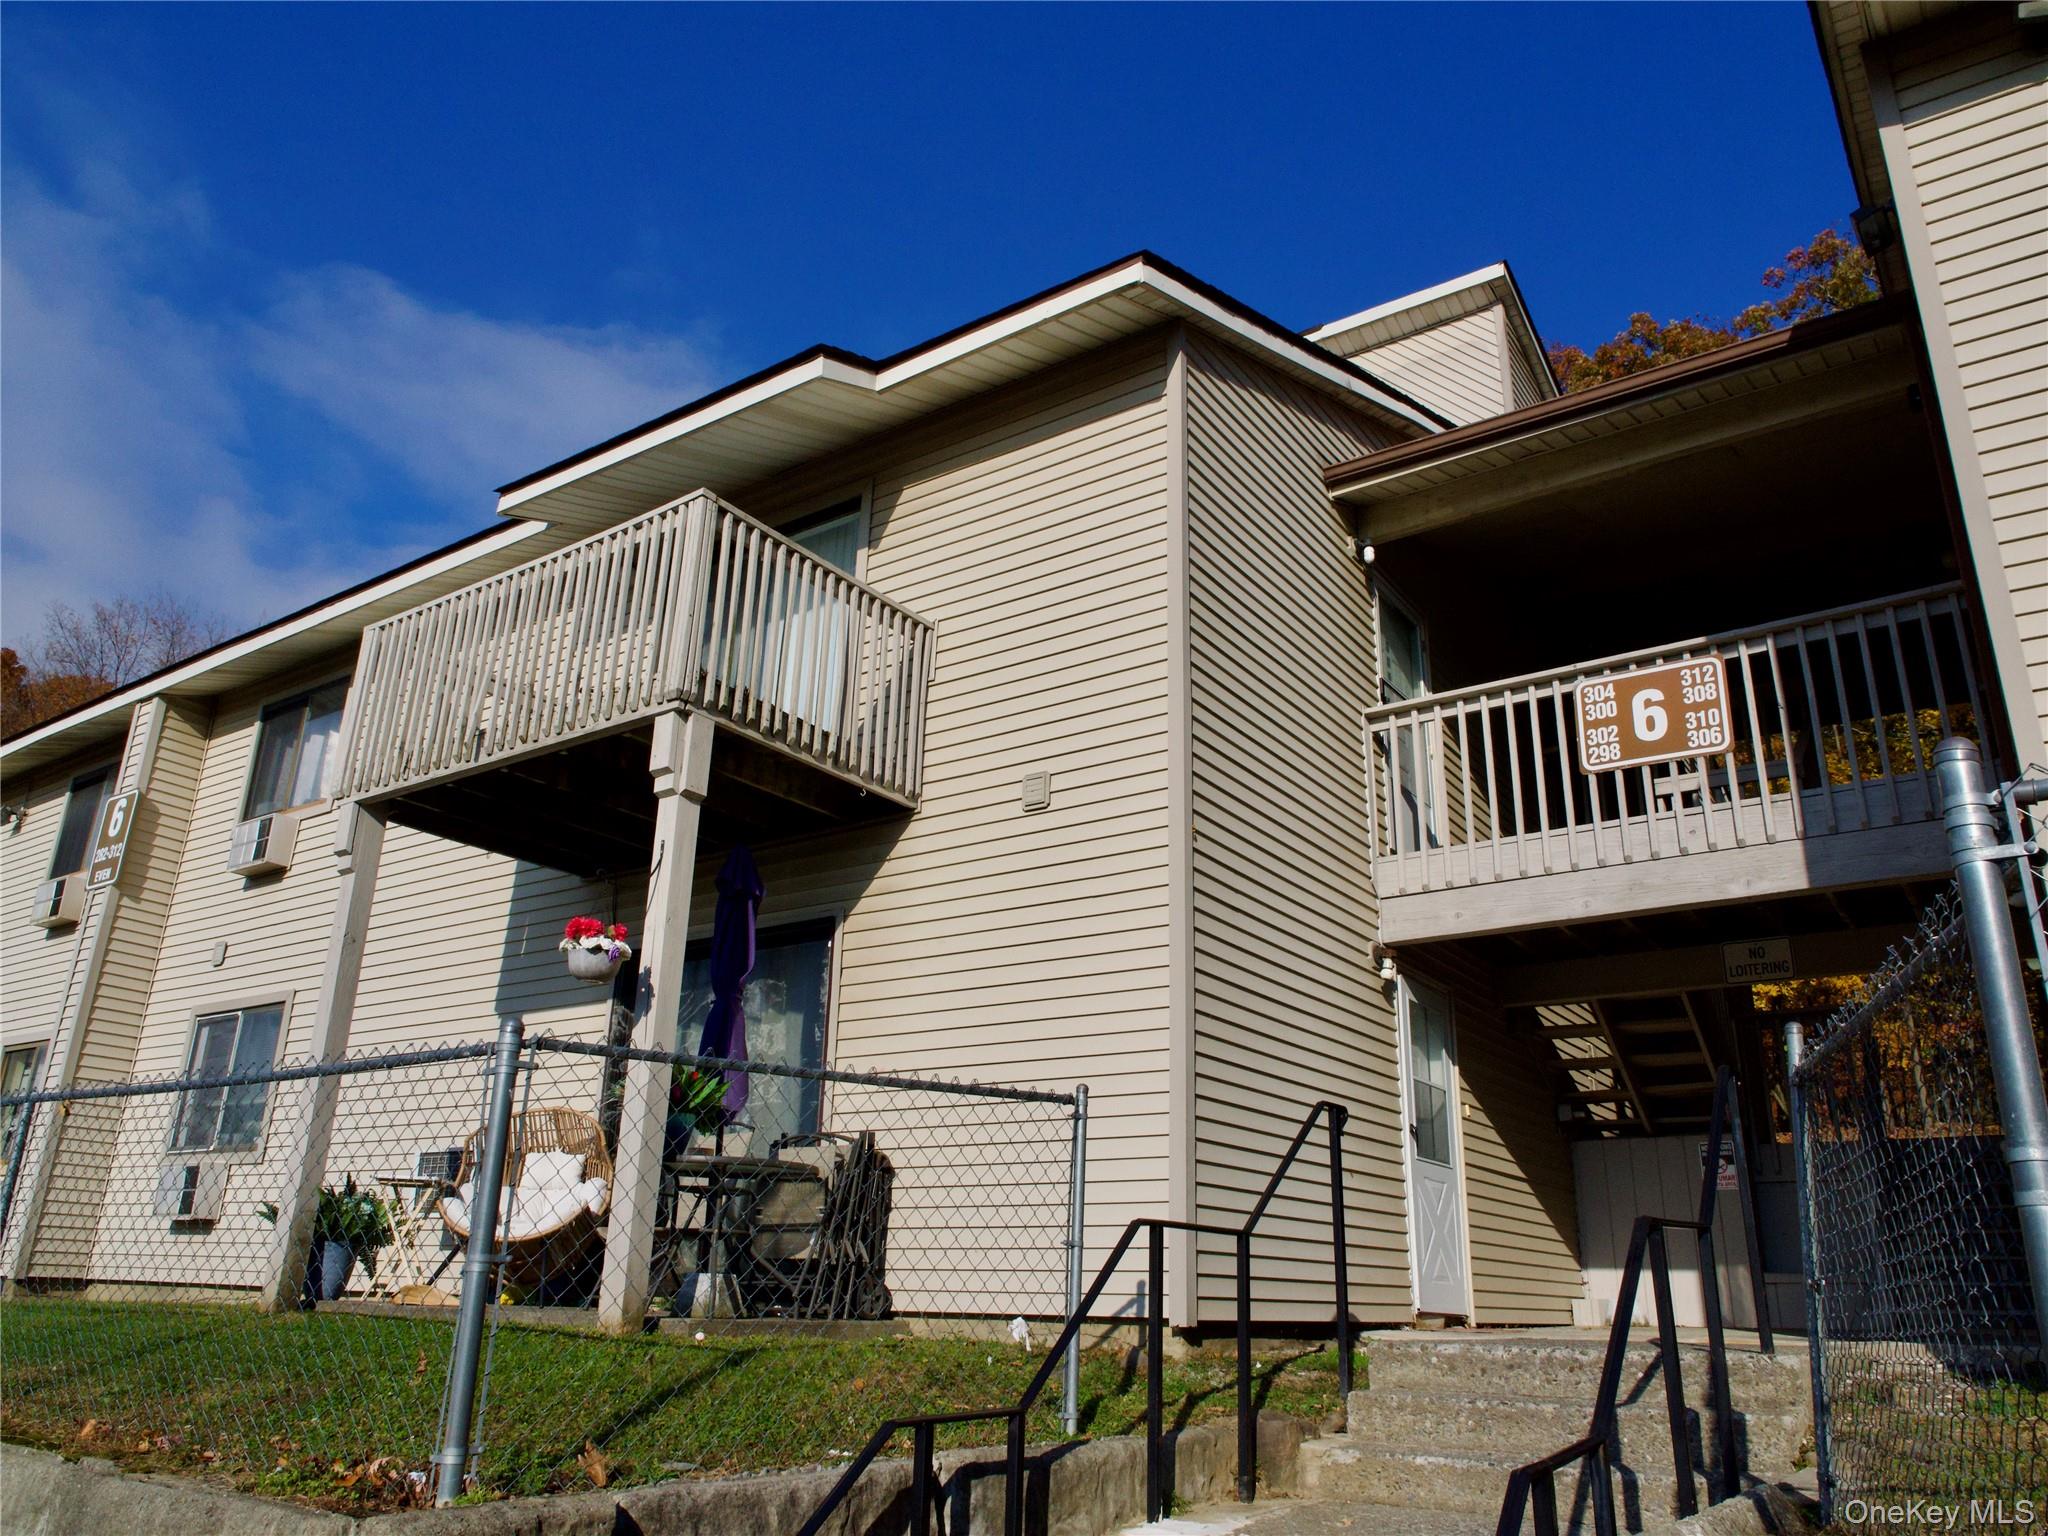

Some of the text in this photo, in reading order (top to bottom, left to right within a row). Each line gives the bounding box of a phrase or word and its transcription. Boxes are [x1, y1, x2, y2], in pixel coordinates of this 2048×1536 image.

[1680, 664, 1715, 687] 312
[1583, 682, 1616, 704] 304
[1682, 682, 1717, 704] 308
[1584, 700, 1618, 721] 300
[1631, 688, 1669, 742] 6
[1684, 708, 1720, 730] 310
[1586, 725, 1620, 746] 302
[1686, 726, 1722, 748] 306
[1588, 742, 1621, 764] 298
[108, 798, 128, 838] 6
[94, 867, 112, 883] EVEN
[1748, 946, 1766, 959] NO
[1728, 960, 1790, 978] LOITERING
